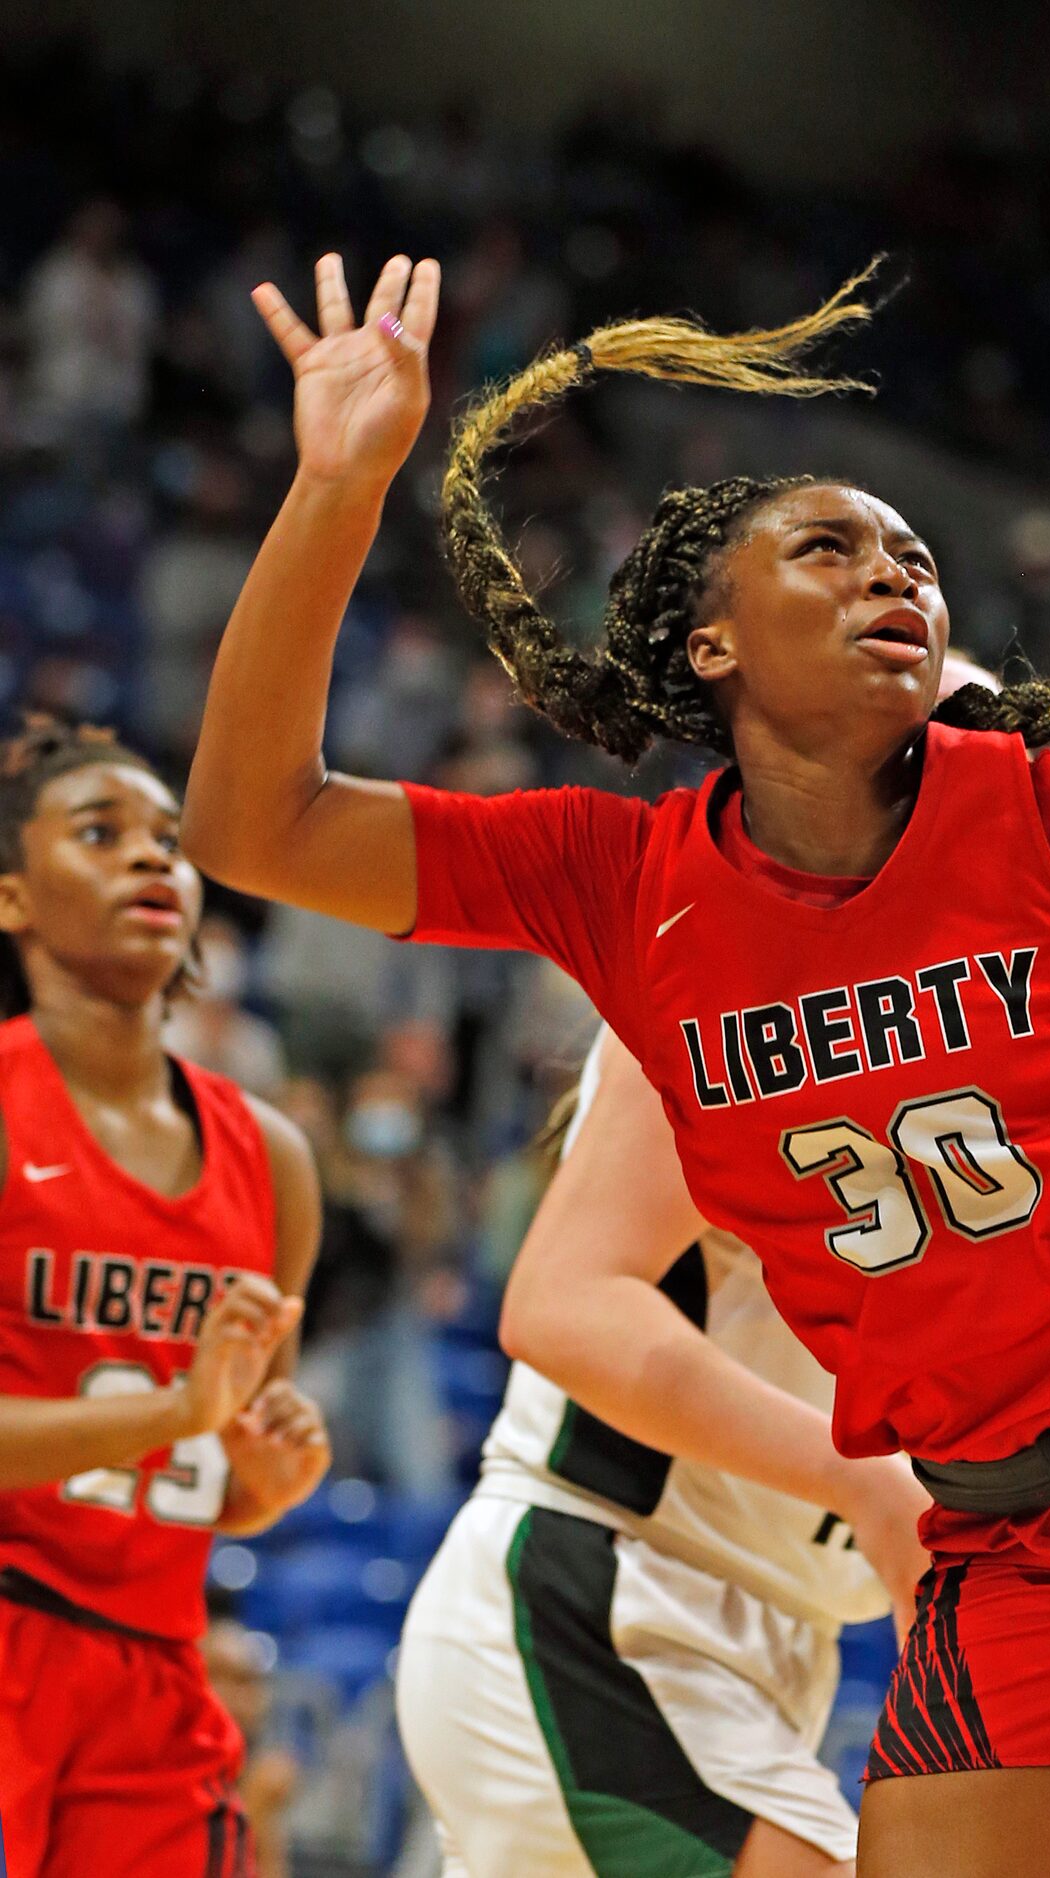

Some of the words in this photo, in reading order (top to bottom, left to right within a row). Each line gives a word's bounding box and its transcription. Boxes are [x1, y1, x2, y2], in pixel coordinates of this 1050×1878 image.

[679, 947, 1038, 1110] LIBERTY
[778, 1084, 1042, 1278] 30
[27, 1247, 236, 1346] LIBER
